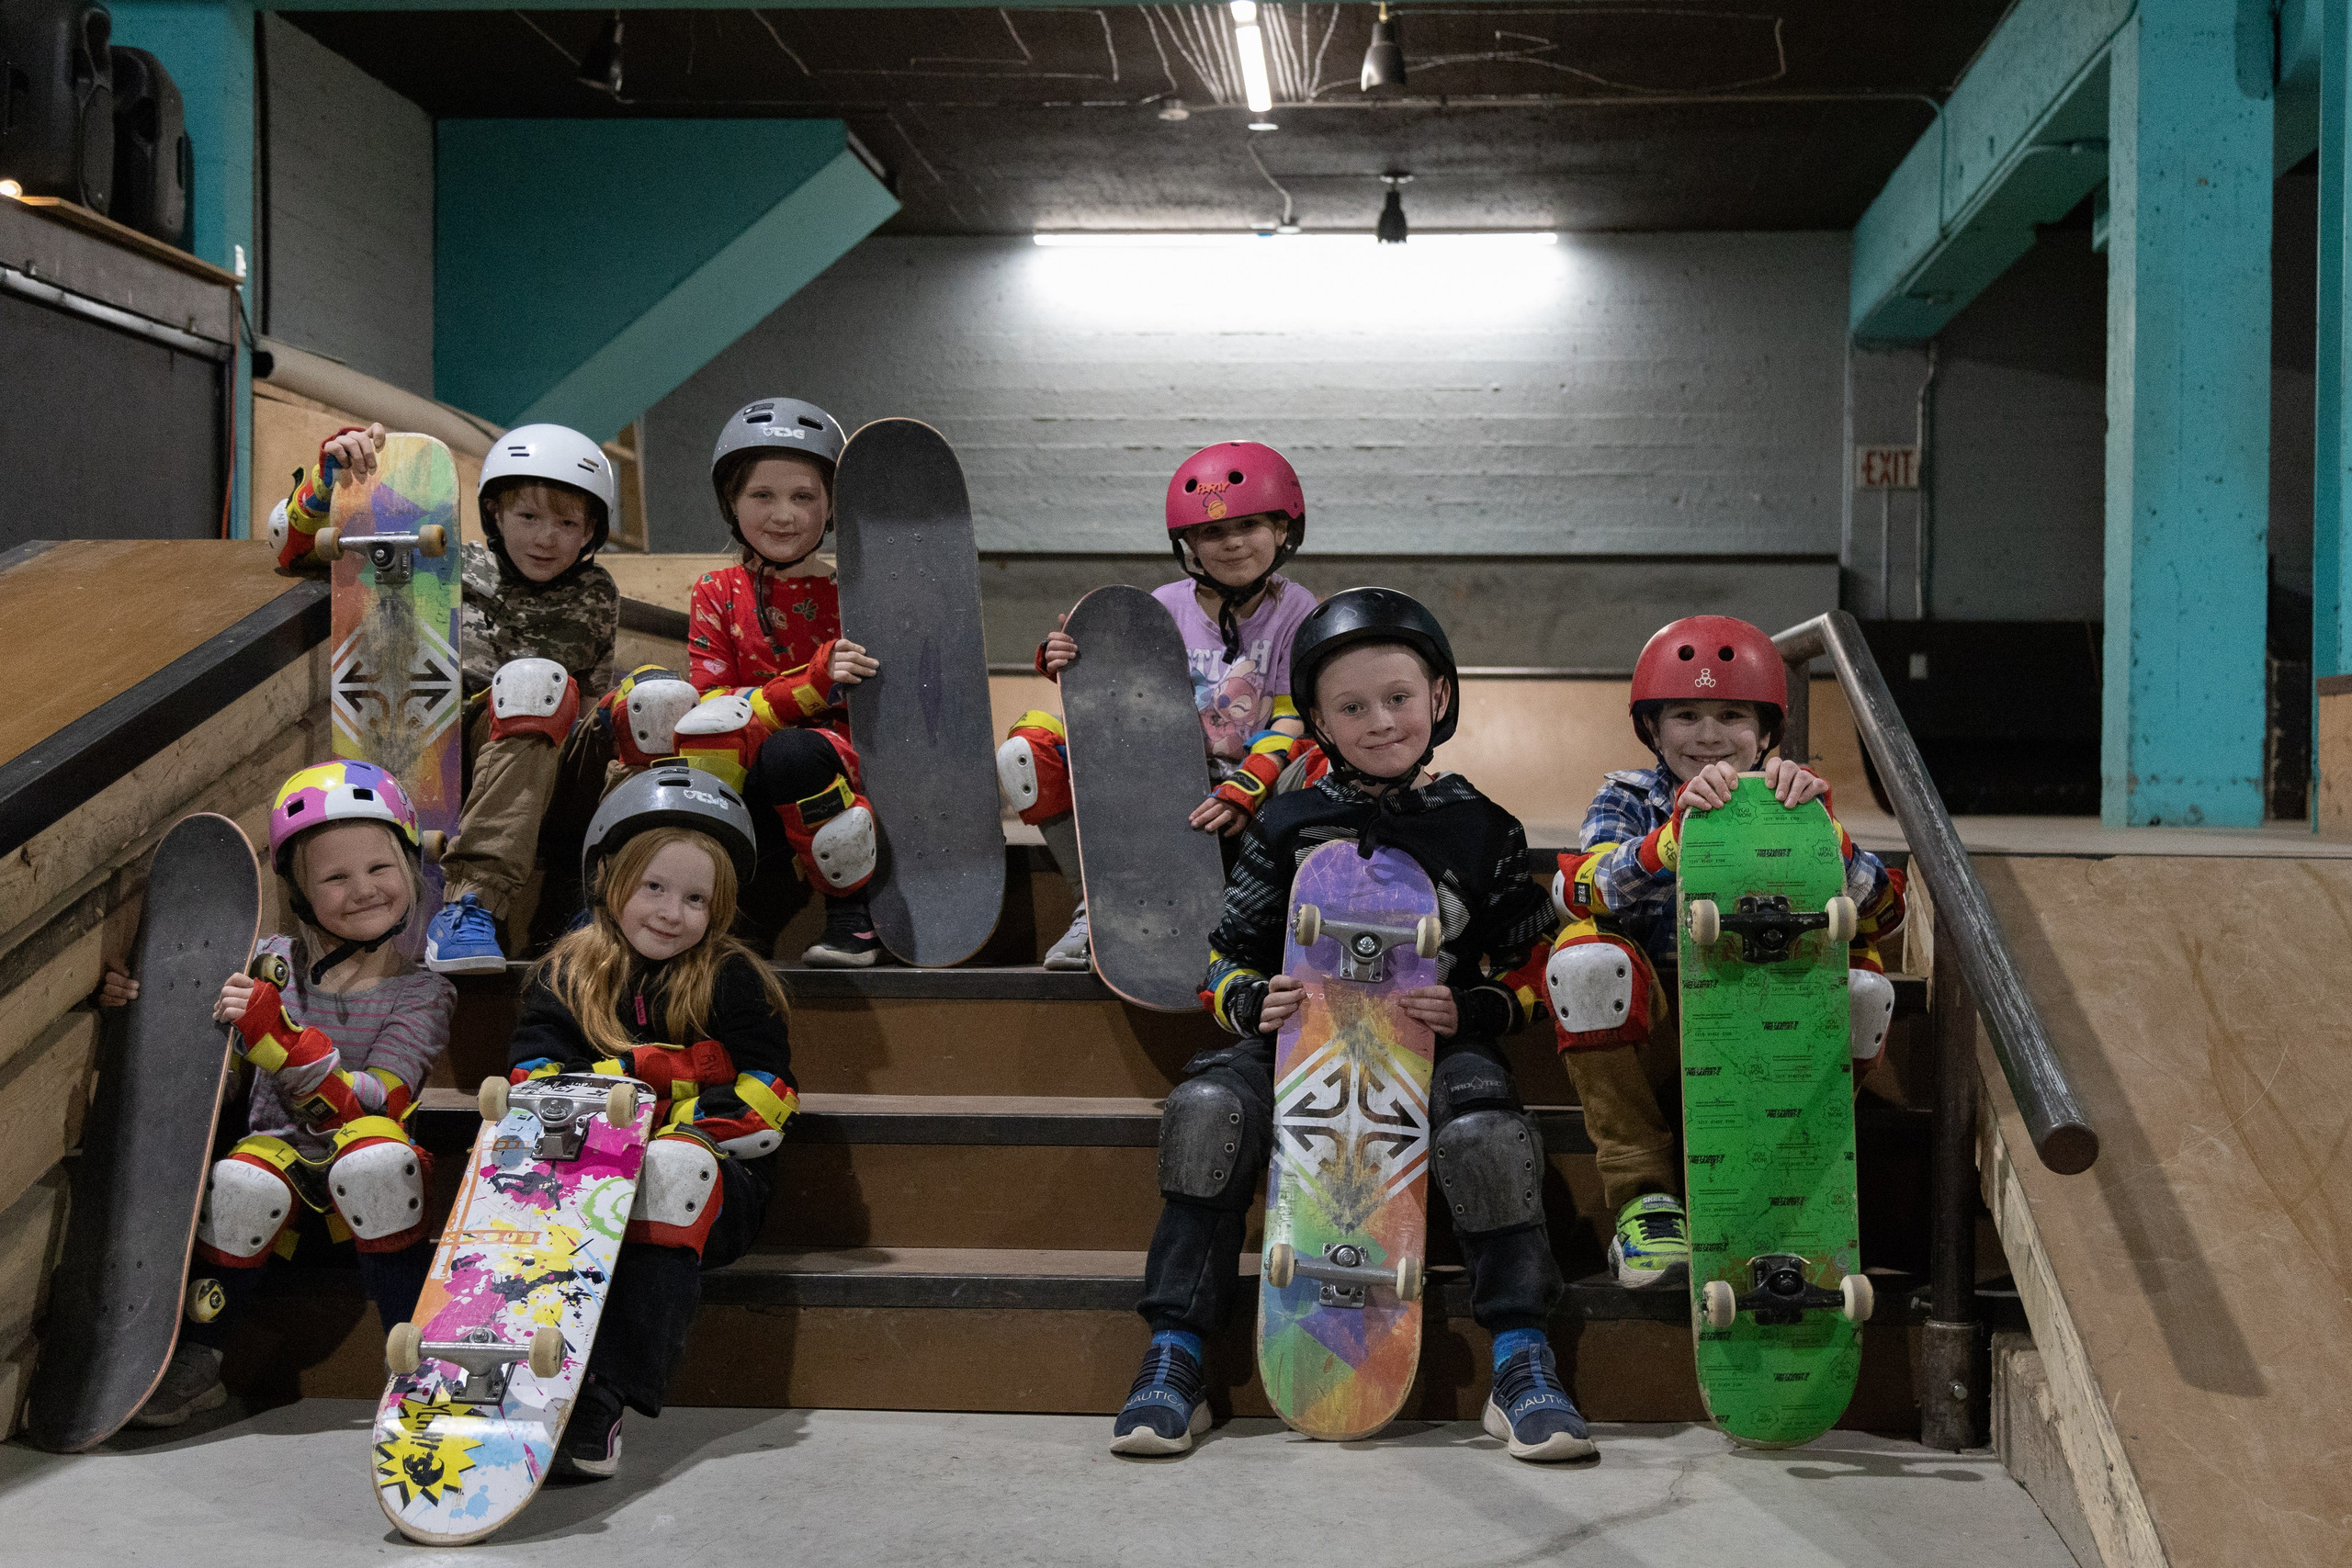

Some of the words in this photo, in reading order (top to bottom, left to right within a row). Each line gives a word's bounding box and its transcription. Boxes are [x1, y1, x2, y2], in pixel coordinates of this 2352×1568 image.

[1865, 451, 1912, 484] EXIT
[1196, 481, 1229, 495] PARTY
[1451, 1082, 1471, 1092] PRO
[1483, 1079, 1502, 1088] TEC
[1124, 1391, 1184, 1412] NAUTICA
[1514, 1394, 1578, 1416] NAUTICA
